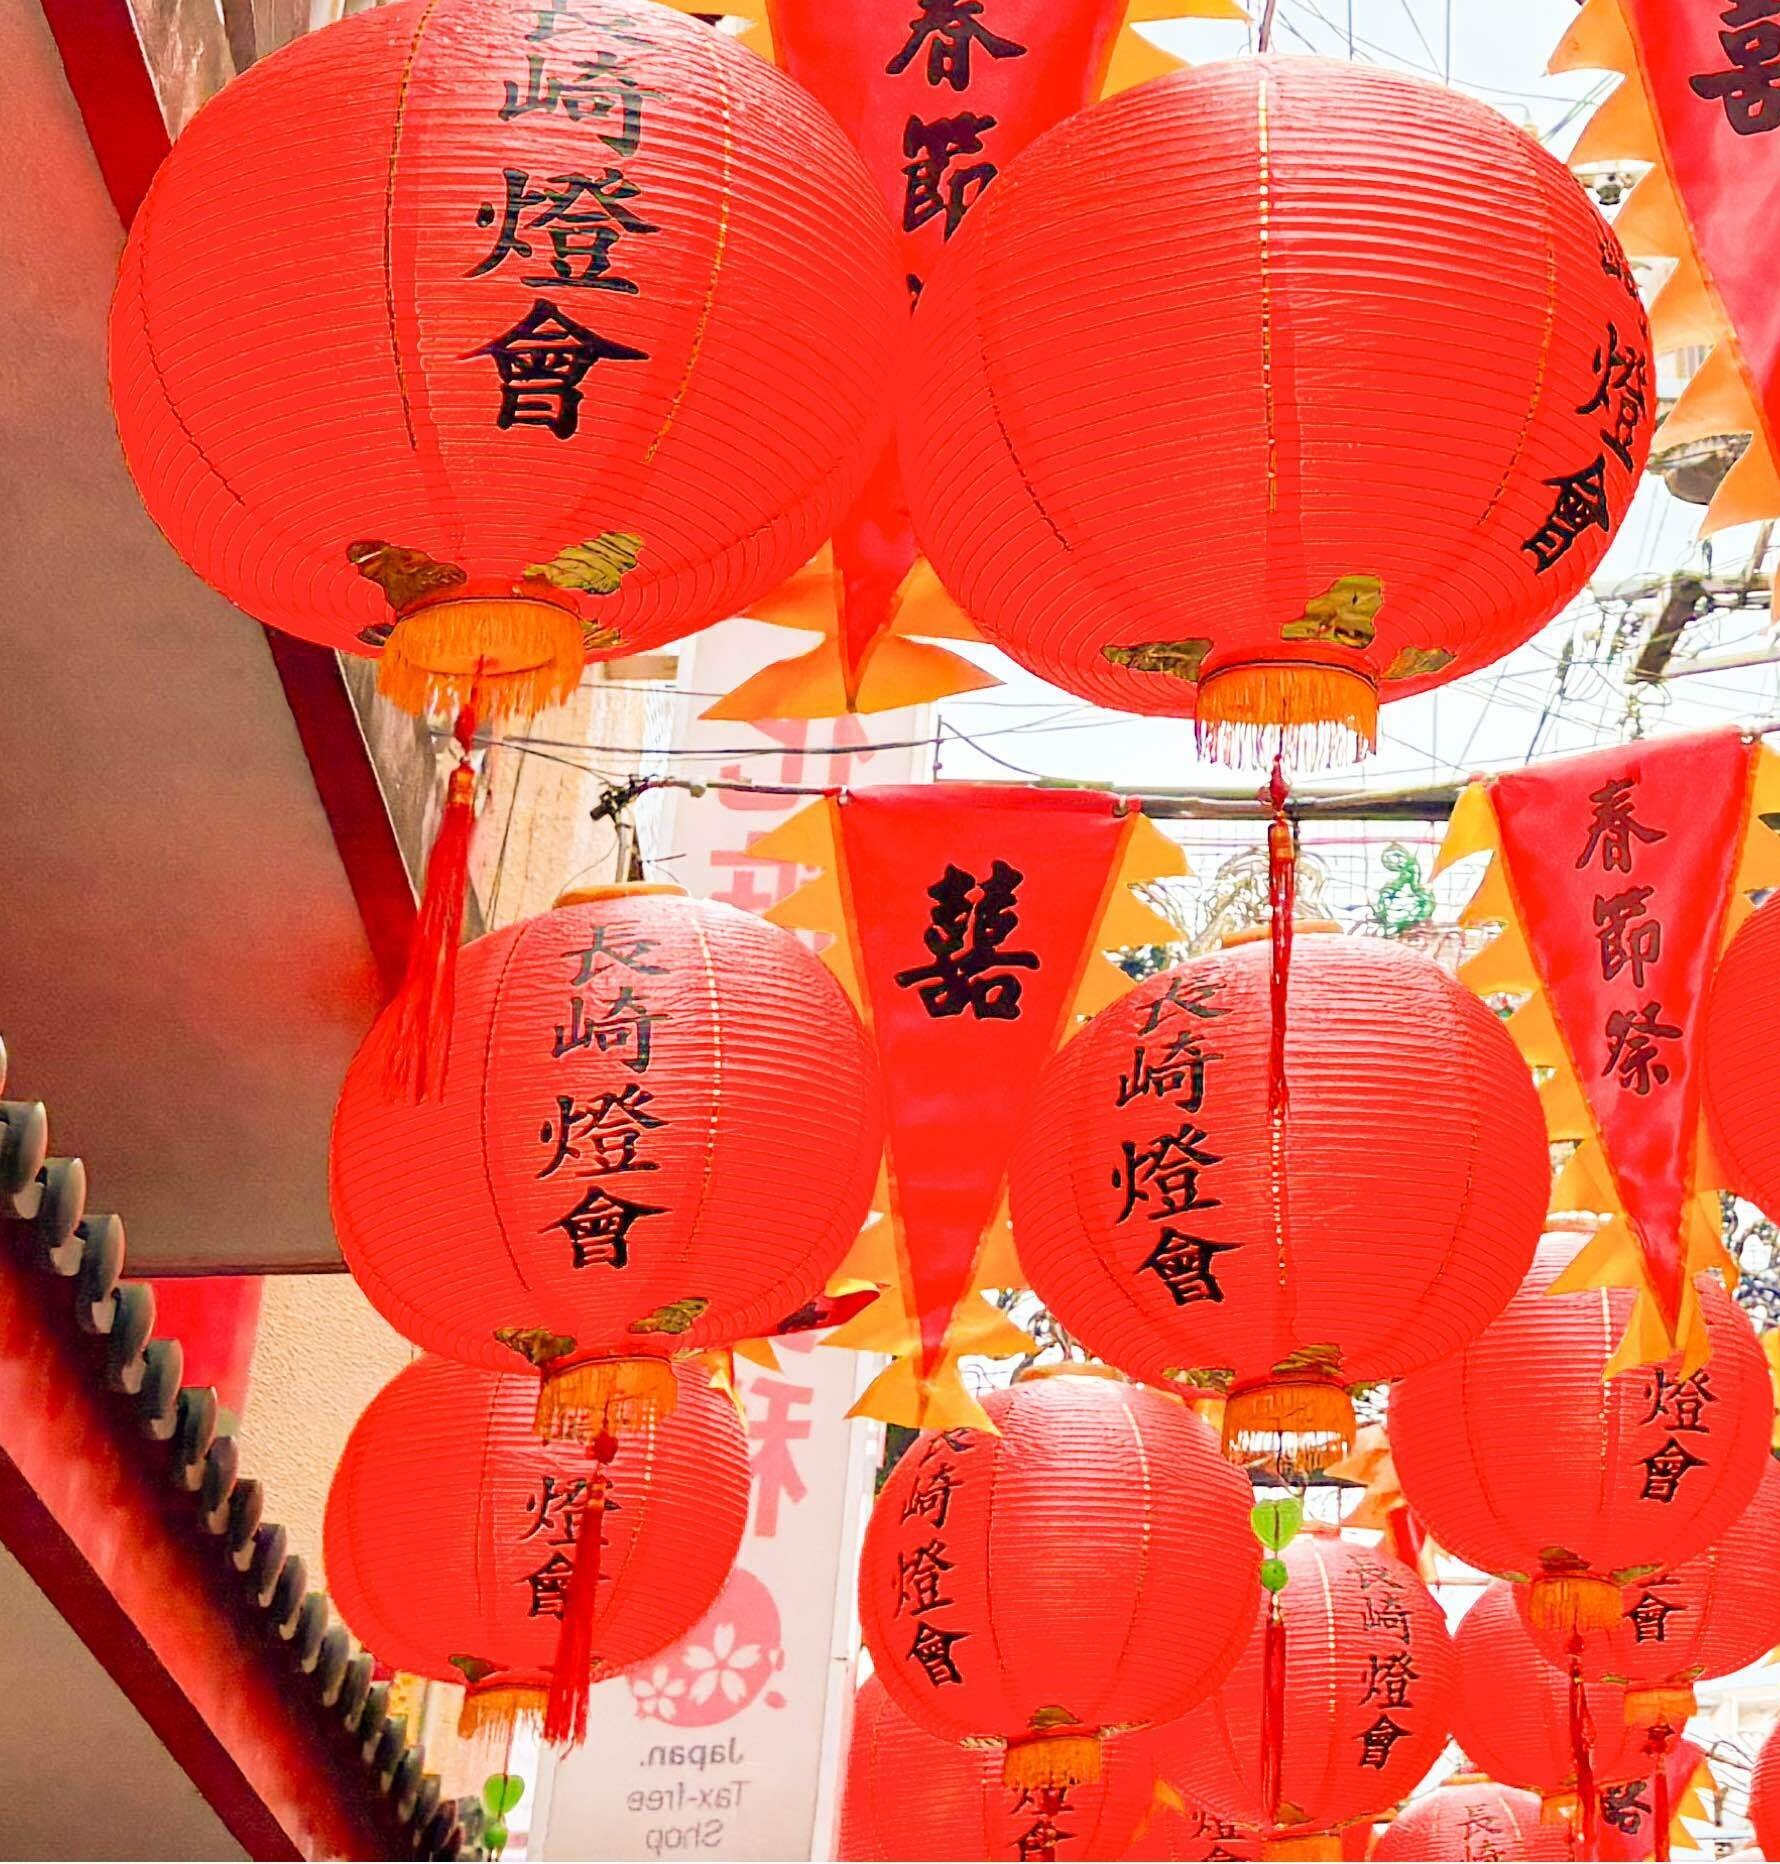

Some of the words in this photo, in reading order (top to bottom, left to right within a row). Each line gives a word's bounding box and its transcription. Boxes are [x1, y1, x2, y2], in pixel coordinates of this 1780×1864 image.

[885, 0, 1028, 316] 春節
[893, 858, 1041, 1021] 囍
[1574, 778, 1684, 1096] 春節祭
[534, 920, 674, 1271] 長崎燈會
[1109, 971, 1248, 1307] 長崎燈會
[1632, 1367, 1721, 1505] 燈會
[1345, 1552, 1422, 1771] 長崎燈會
[1621, 1574, 1690, 1644] 會
